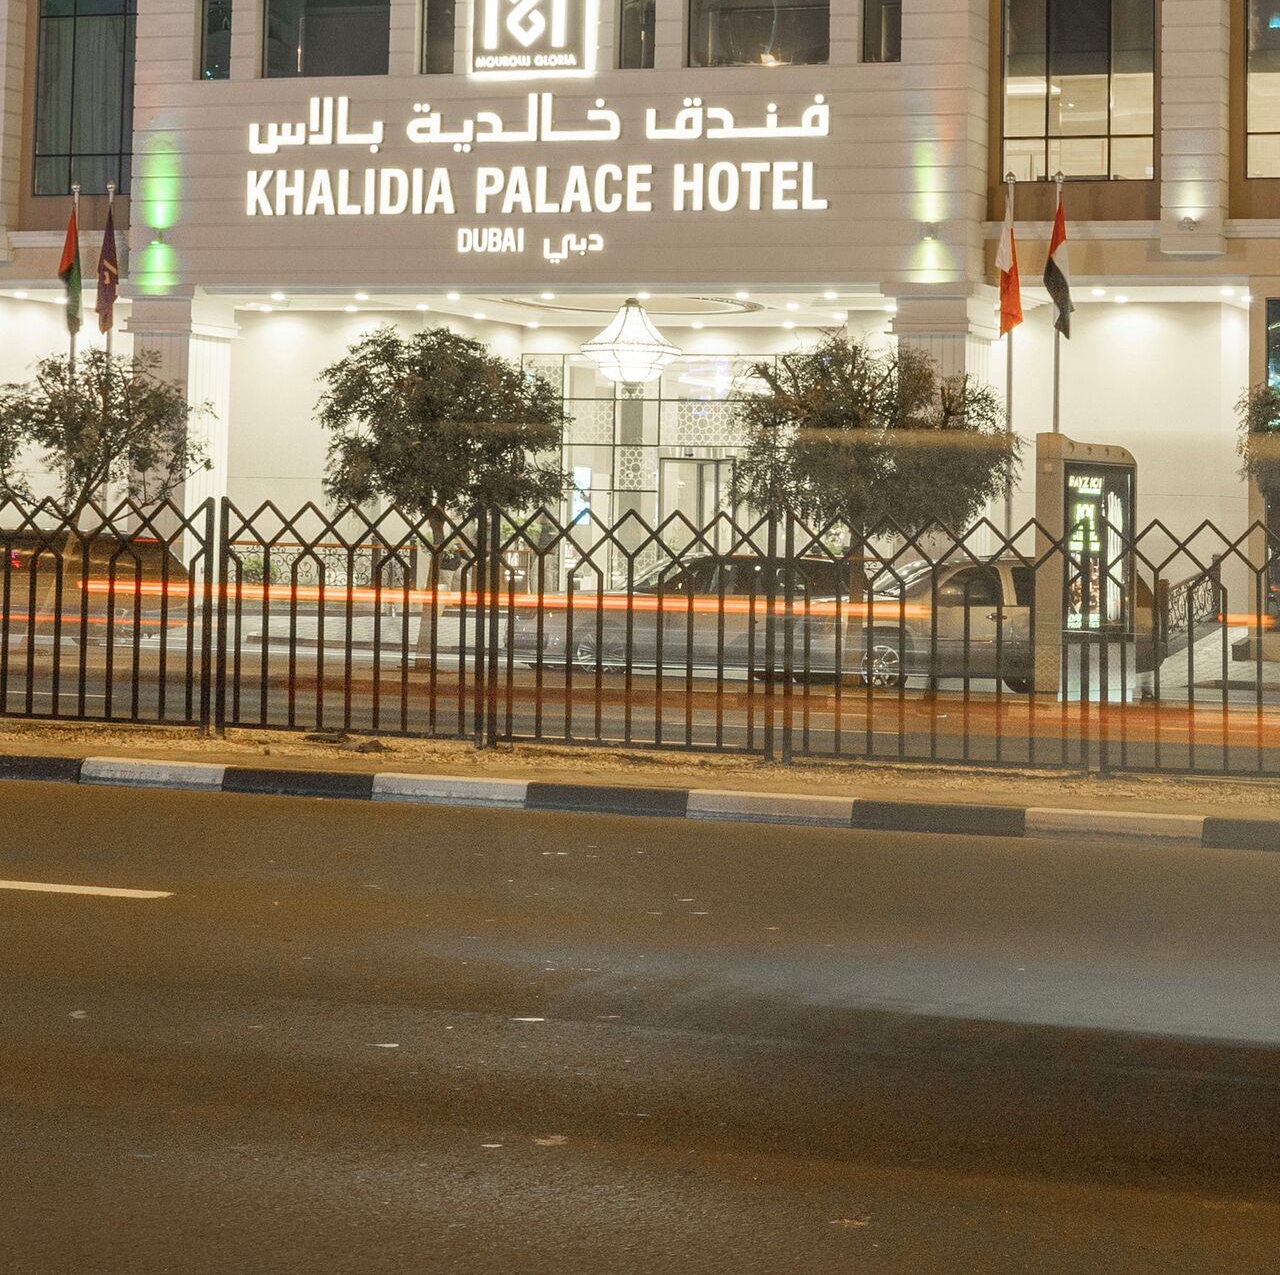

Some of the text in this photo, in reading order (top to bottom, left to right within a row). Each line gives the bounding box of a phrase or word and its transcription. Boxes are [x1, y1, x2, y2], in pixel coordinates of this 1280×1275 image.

[534, 53, 577, 66] GLORIA
[248, 92, 830, 154] فندق خالدية بالاس
[246, 161, 829, 216] KHALIDIA PALACE HOTEL
[457, 227, 525, 253] DUBAI
[543, 233, 604, 264] دبي
